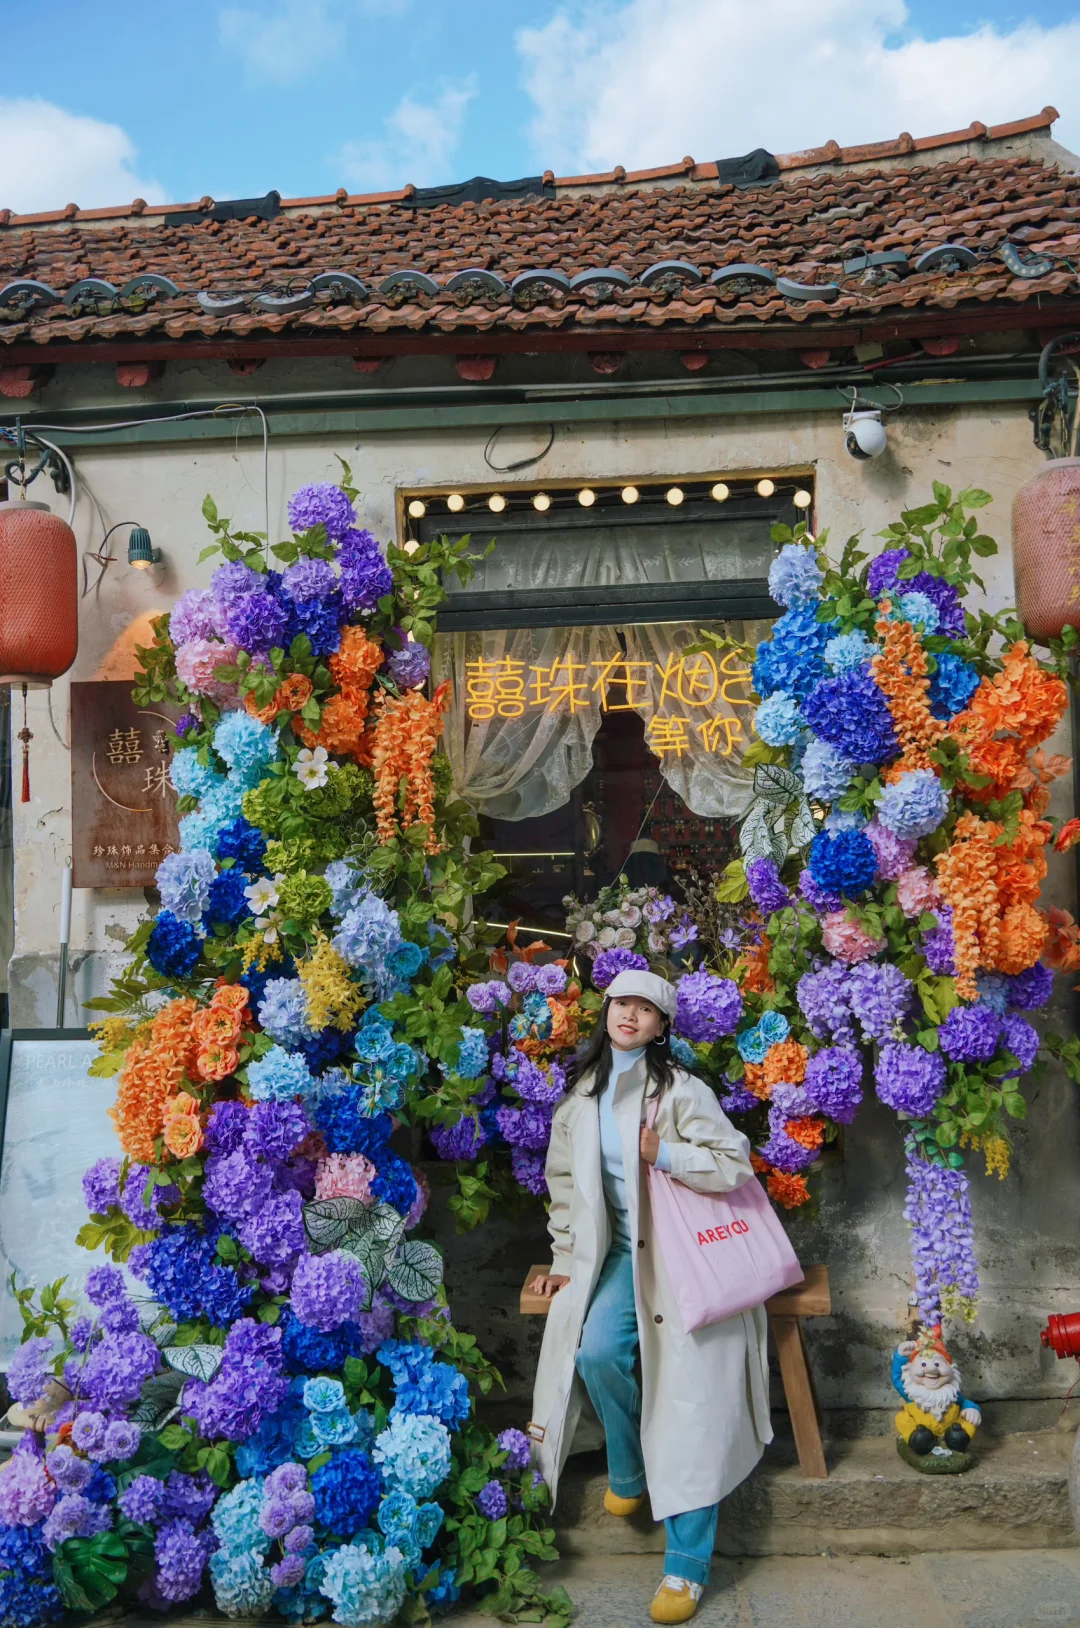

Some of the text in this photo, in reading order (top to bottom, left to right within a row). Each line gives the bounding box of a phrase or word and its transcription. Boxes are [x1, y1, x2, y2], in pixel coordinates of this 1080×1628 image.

[141, 760, 177, 799] 珠
[93, 843, 183, 857] 珍珠饰品集合
[128, 861, 162, 869] Handm
[25, 1054, 76, 1069] PEARL
